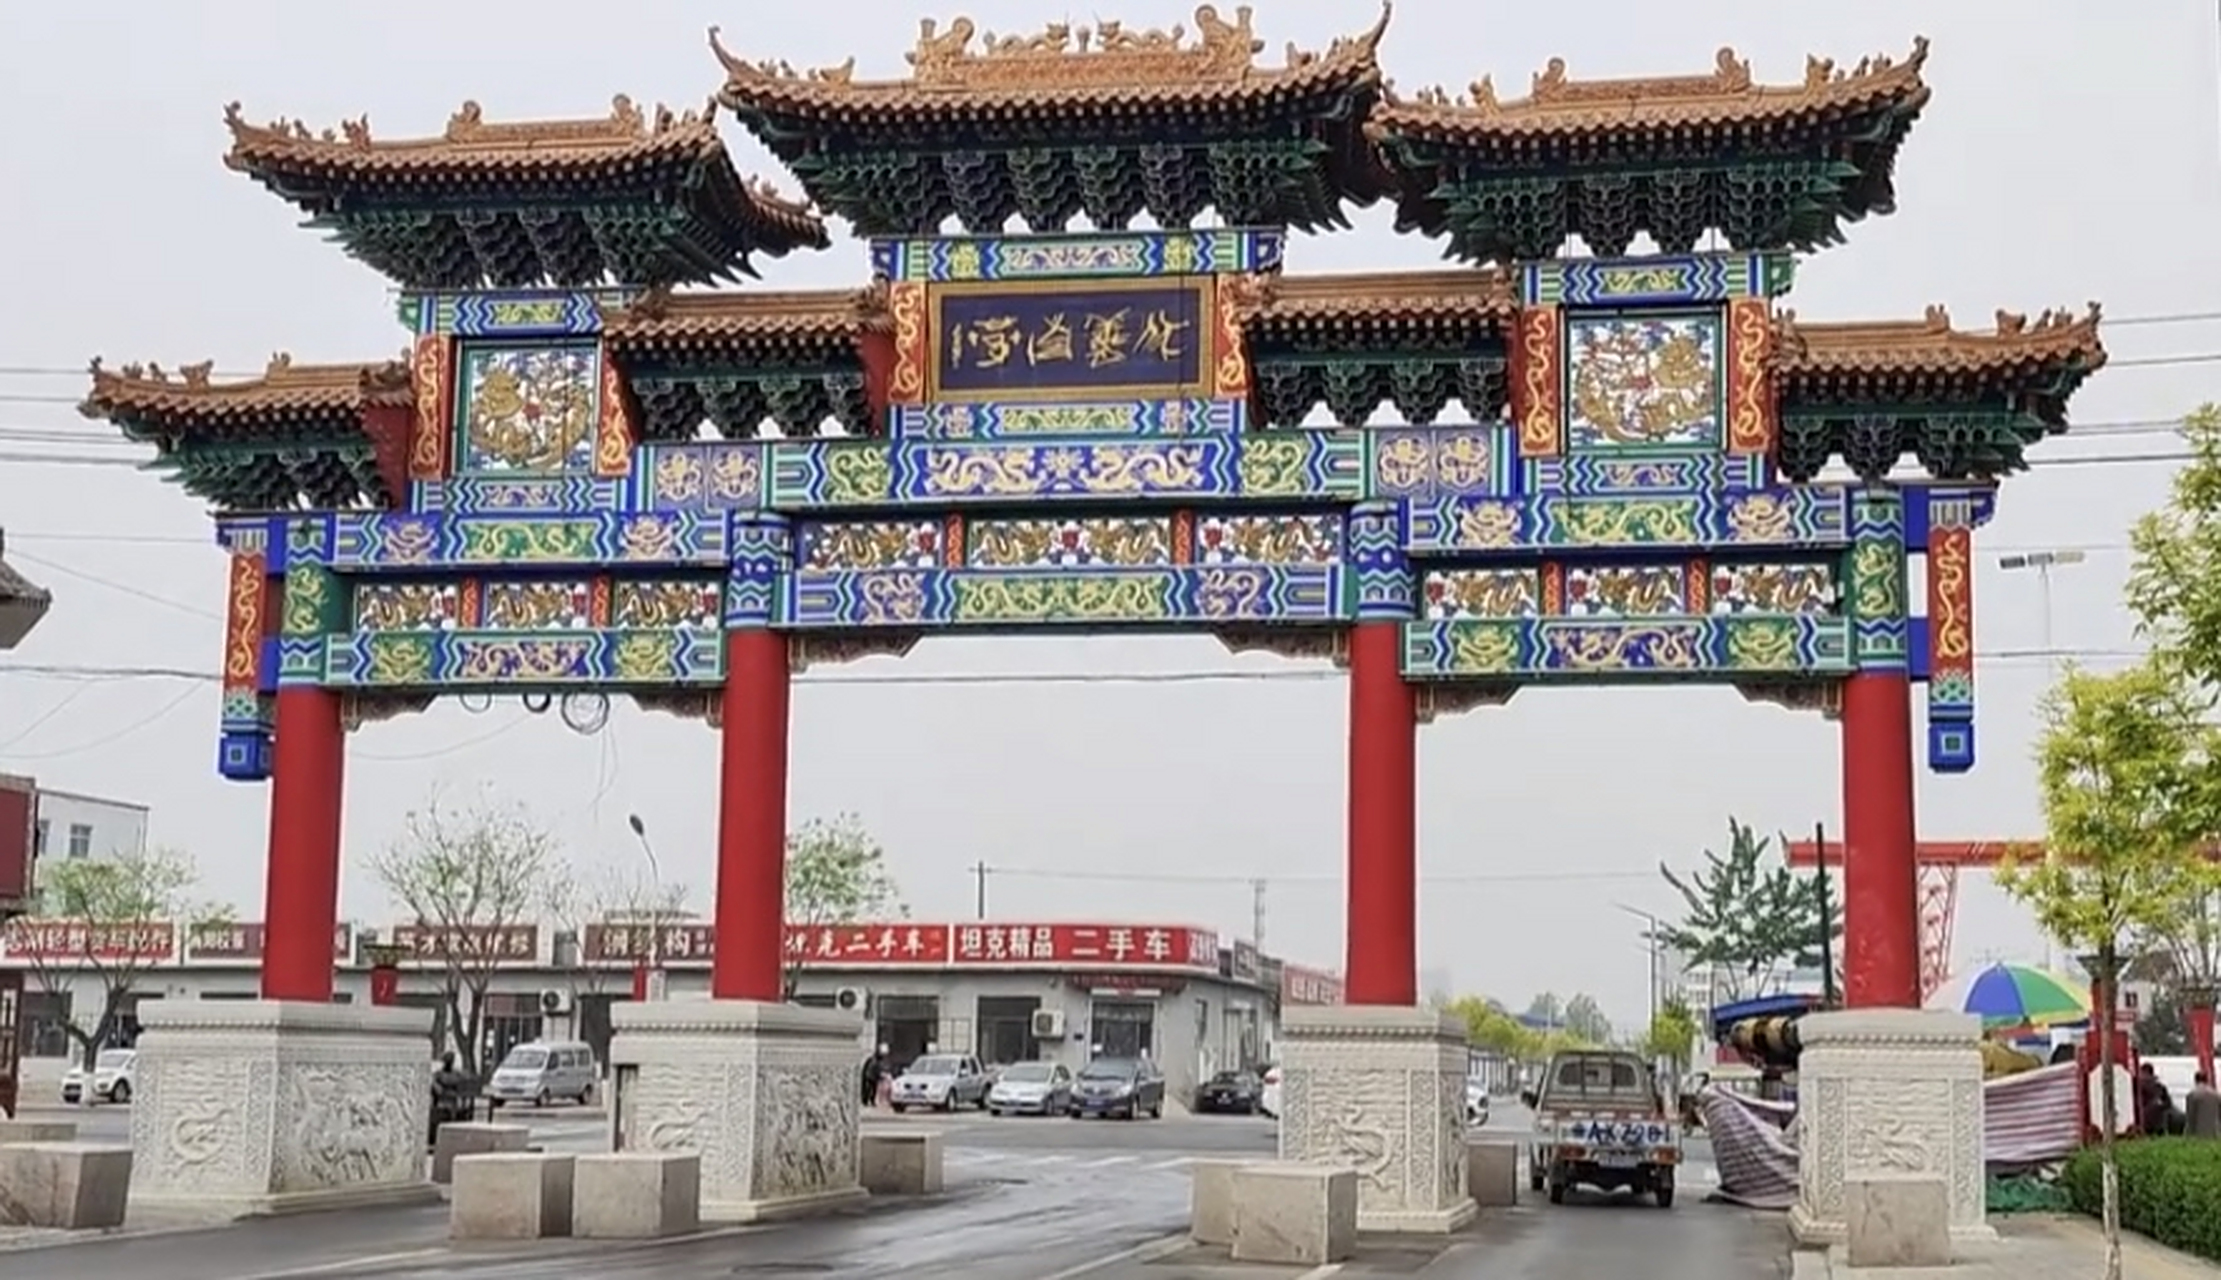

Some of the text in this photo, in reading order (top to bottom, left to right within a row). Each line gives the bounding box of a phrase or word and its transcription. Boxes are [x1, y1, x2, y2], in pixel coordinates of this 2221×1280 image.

[960, 927, 1053, 959] 坦克精品
[1071, 929, 1170, 960] 二手车
